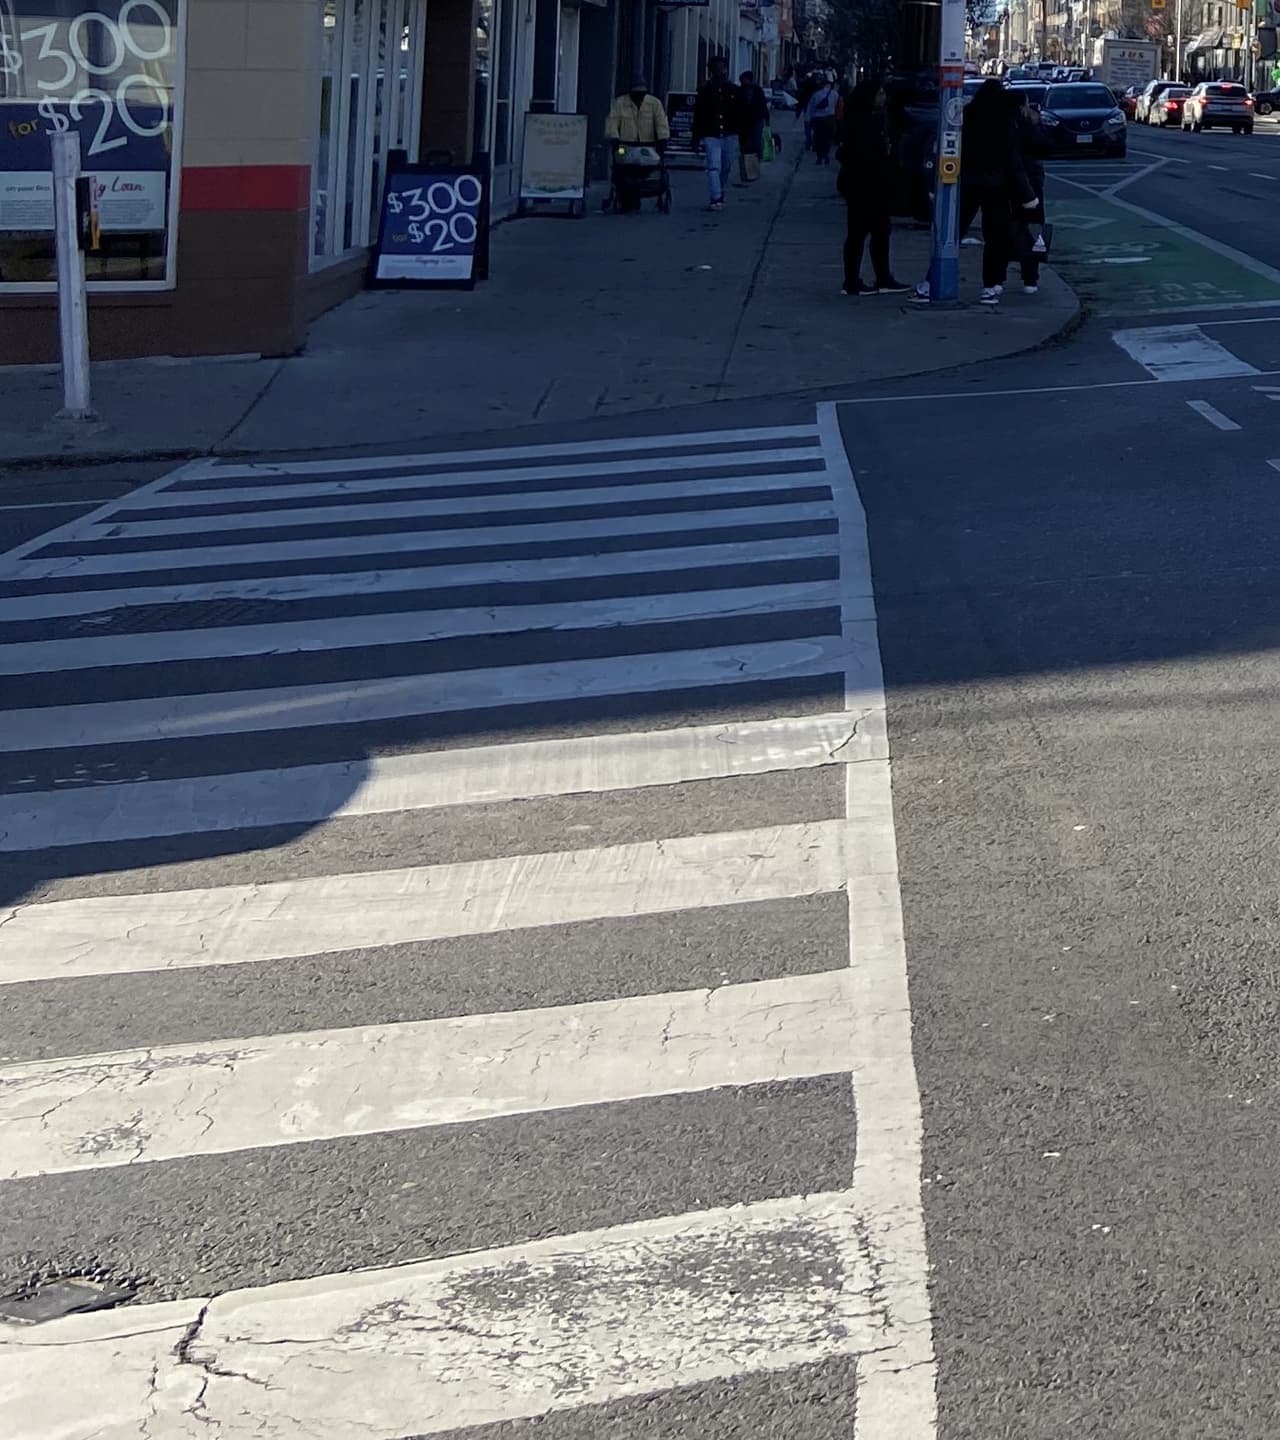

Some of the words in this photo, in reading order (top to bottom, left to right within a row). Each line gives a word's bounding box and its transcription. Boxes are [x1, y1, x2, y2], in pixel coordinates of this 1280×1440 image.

[38, 74, 168, 156] $20
[112, 175, 145, 193] Loan
[387, 174, 483, 221] $300
[408, 212, 477, 252] $20
